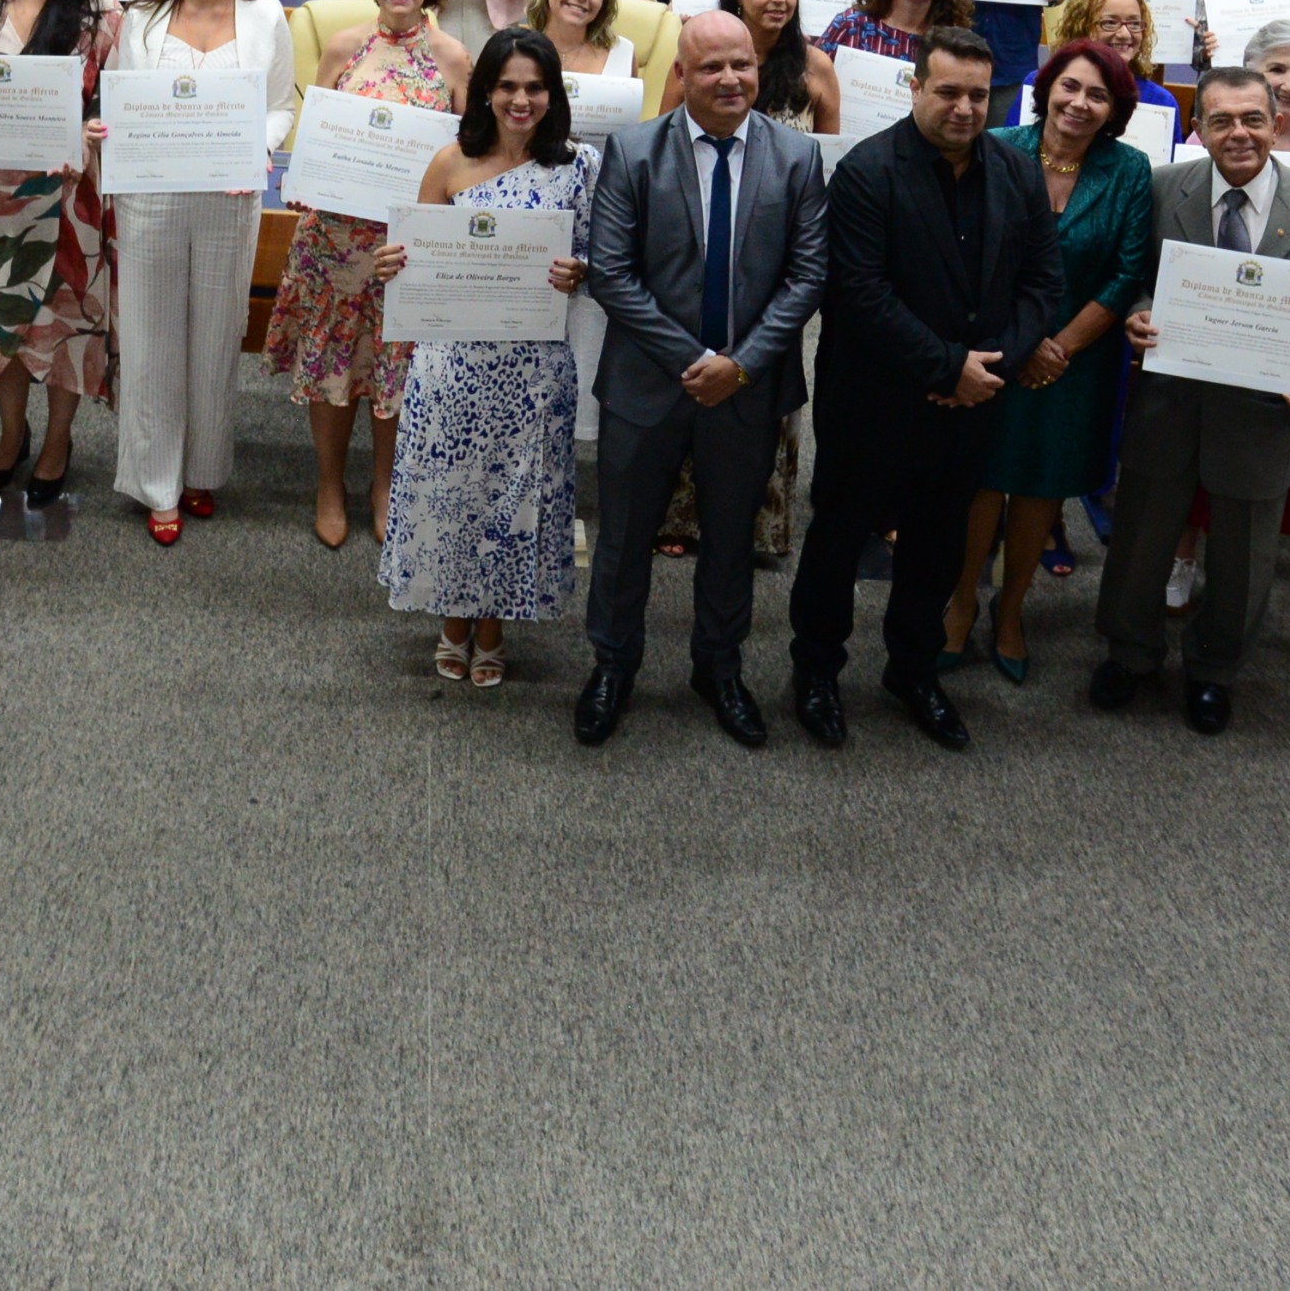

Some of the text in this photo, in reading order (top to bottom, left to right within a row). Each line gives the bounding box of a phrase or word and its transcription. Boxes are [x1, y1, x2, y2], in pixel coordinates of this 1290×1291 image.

[32, 87, 59, 96] Mérito
[123, 102, 160, 113] Diploma
[162, 102, 172, 110] de
[175, 102, 202, 112] Honra
[216, 102, 246, 111] Mérito
[128, 132, 150, 140] Regina
[171, 131, 204, 140] Gonçalves
[320, 121, 354, 135] Diploma
[356, 128, 364, 137] de
[368, 130, 393, 143] Honra
[406, 138, 435, 151] Mérito
[412, 239, 454, 251] Diploma
[456, 241, 466, 250] de
[470, 241, 500, 252] Honra
[516, 243, 548, 253] Mérito
[496, 274, 520, 283] Borges
[1180, 279, 1220, 294] Diploma
[1222, 286, 1232, 296] de
[1236, 288, 1264, 301] Honra
[1204, 315, 1229, 326] Vagner
